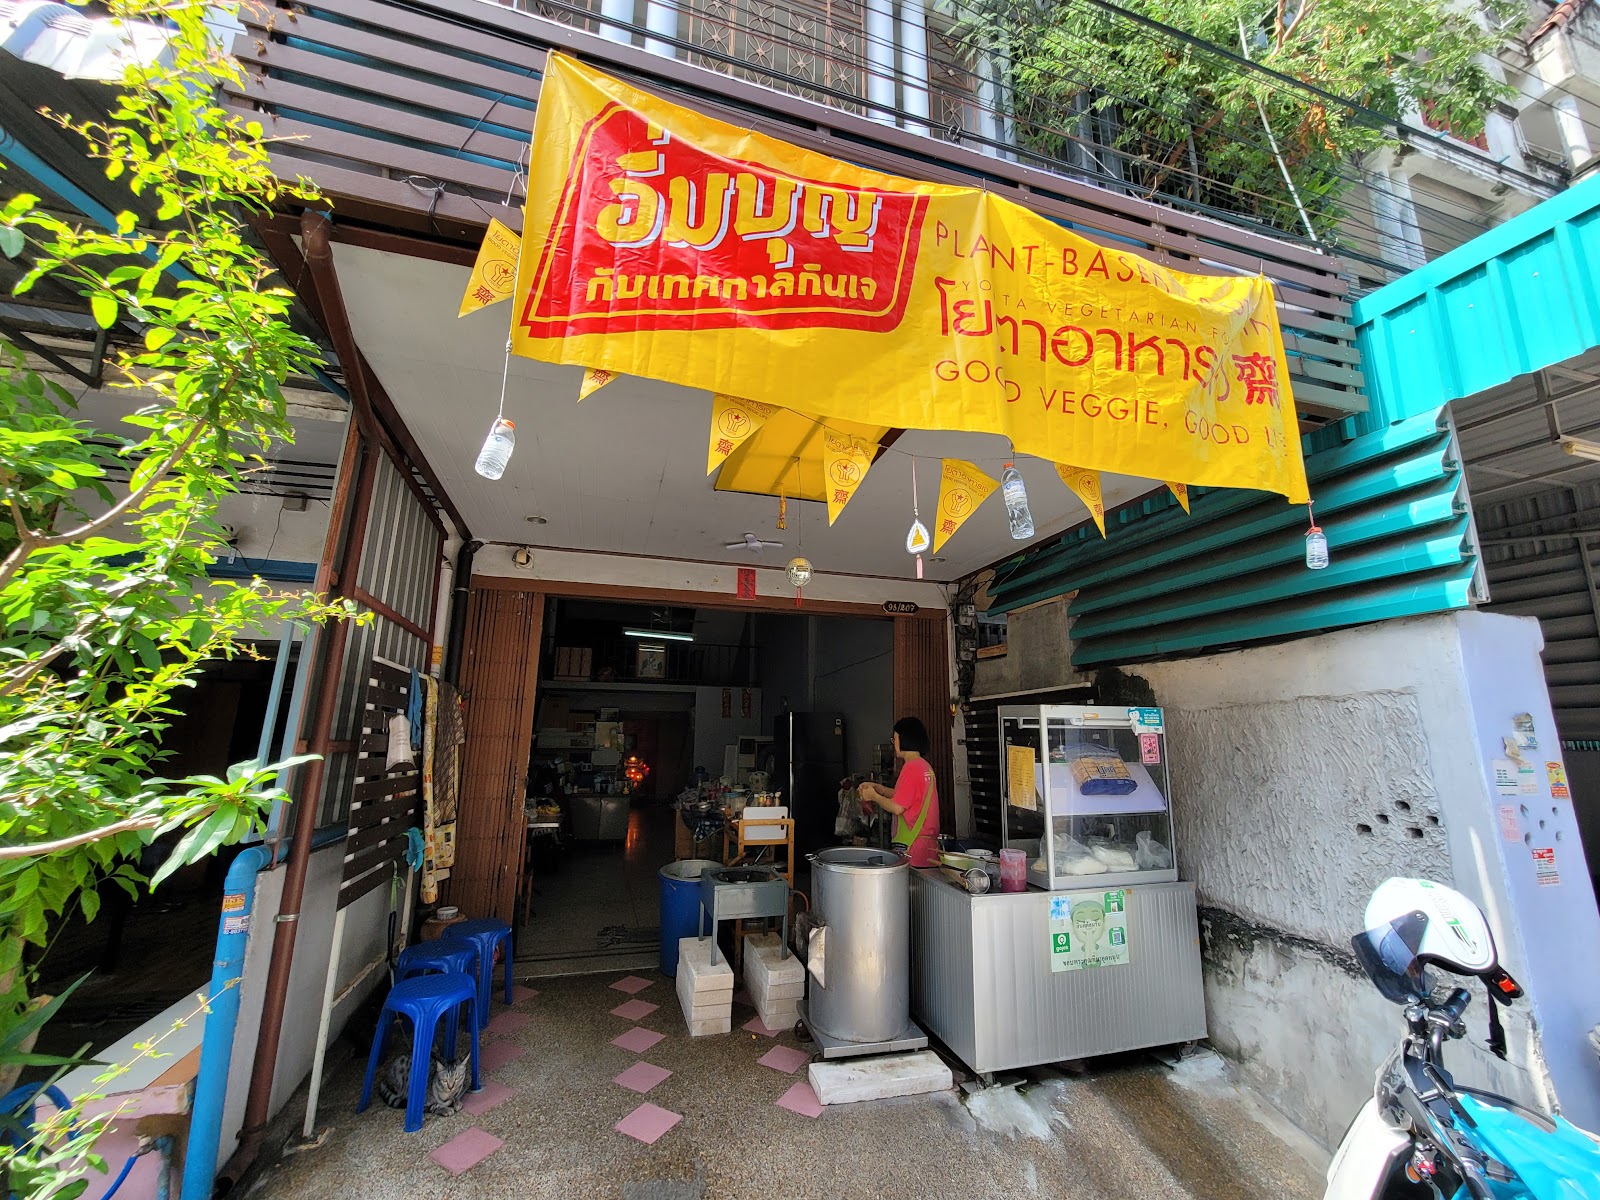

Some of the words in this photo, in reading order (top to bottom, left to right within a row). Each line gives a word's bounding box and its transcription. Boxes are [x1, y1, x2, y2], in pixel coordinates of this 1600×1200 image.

[586, 264, 878, 301] กับเทศกาลกินเจ
[1047, 302, 1197, 334] VEGETARIAN
[1039, 386, 1168, 430] VEGGIE,
[1184, 409, 1250, 444] GOOD
